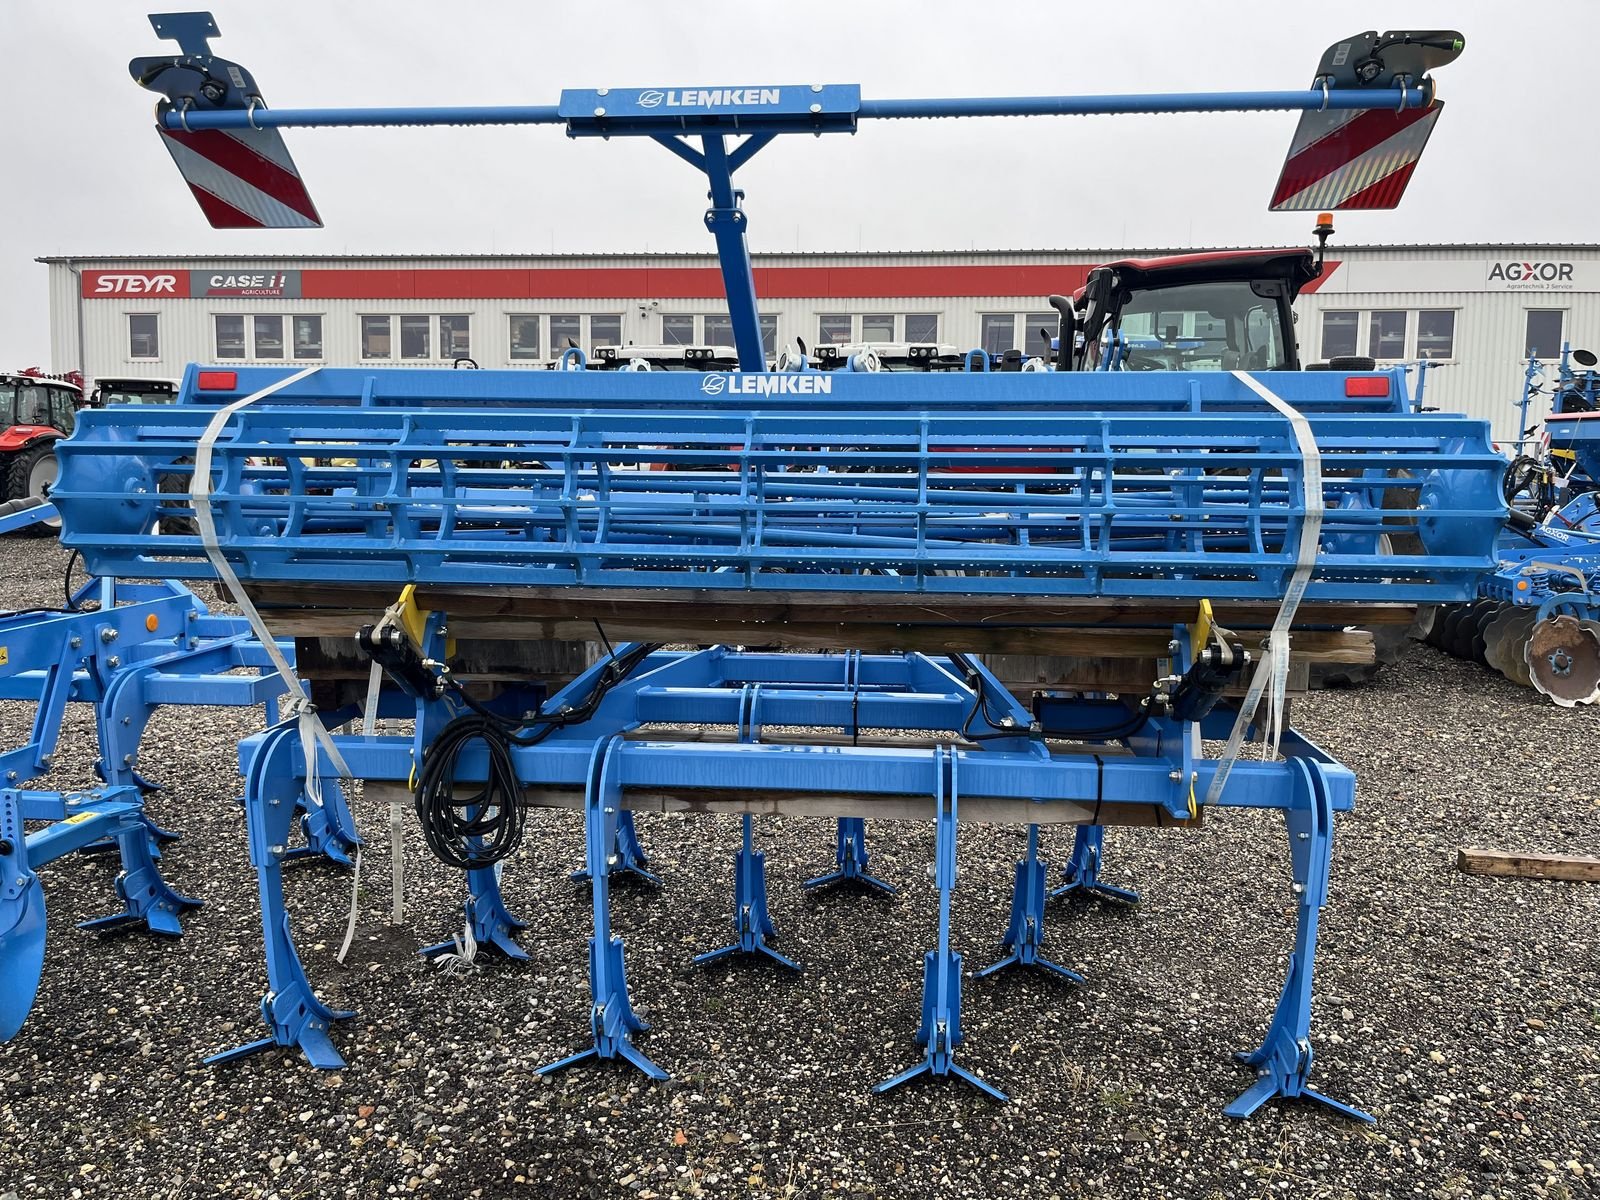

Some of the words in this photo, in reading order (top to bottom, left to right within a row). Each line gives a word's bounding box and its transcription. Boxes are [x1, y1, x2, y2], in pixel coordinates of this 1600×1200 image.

[666, 89, 780, 109] LEMKEN
[1488, 263, 1574, 281] AGXOR
[94, 275, 177, 293] STEYR
[210, 275, 265, 288] CASE
[728, 375, 832, 398] LEMKEN
[1539, 525, 1569, 541] AGXOR
